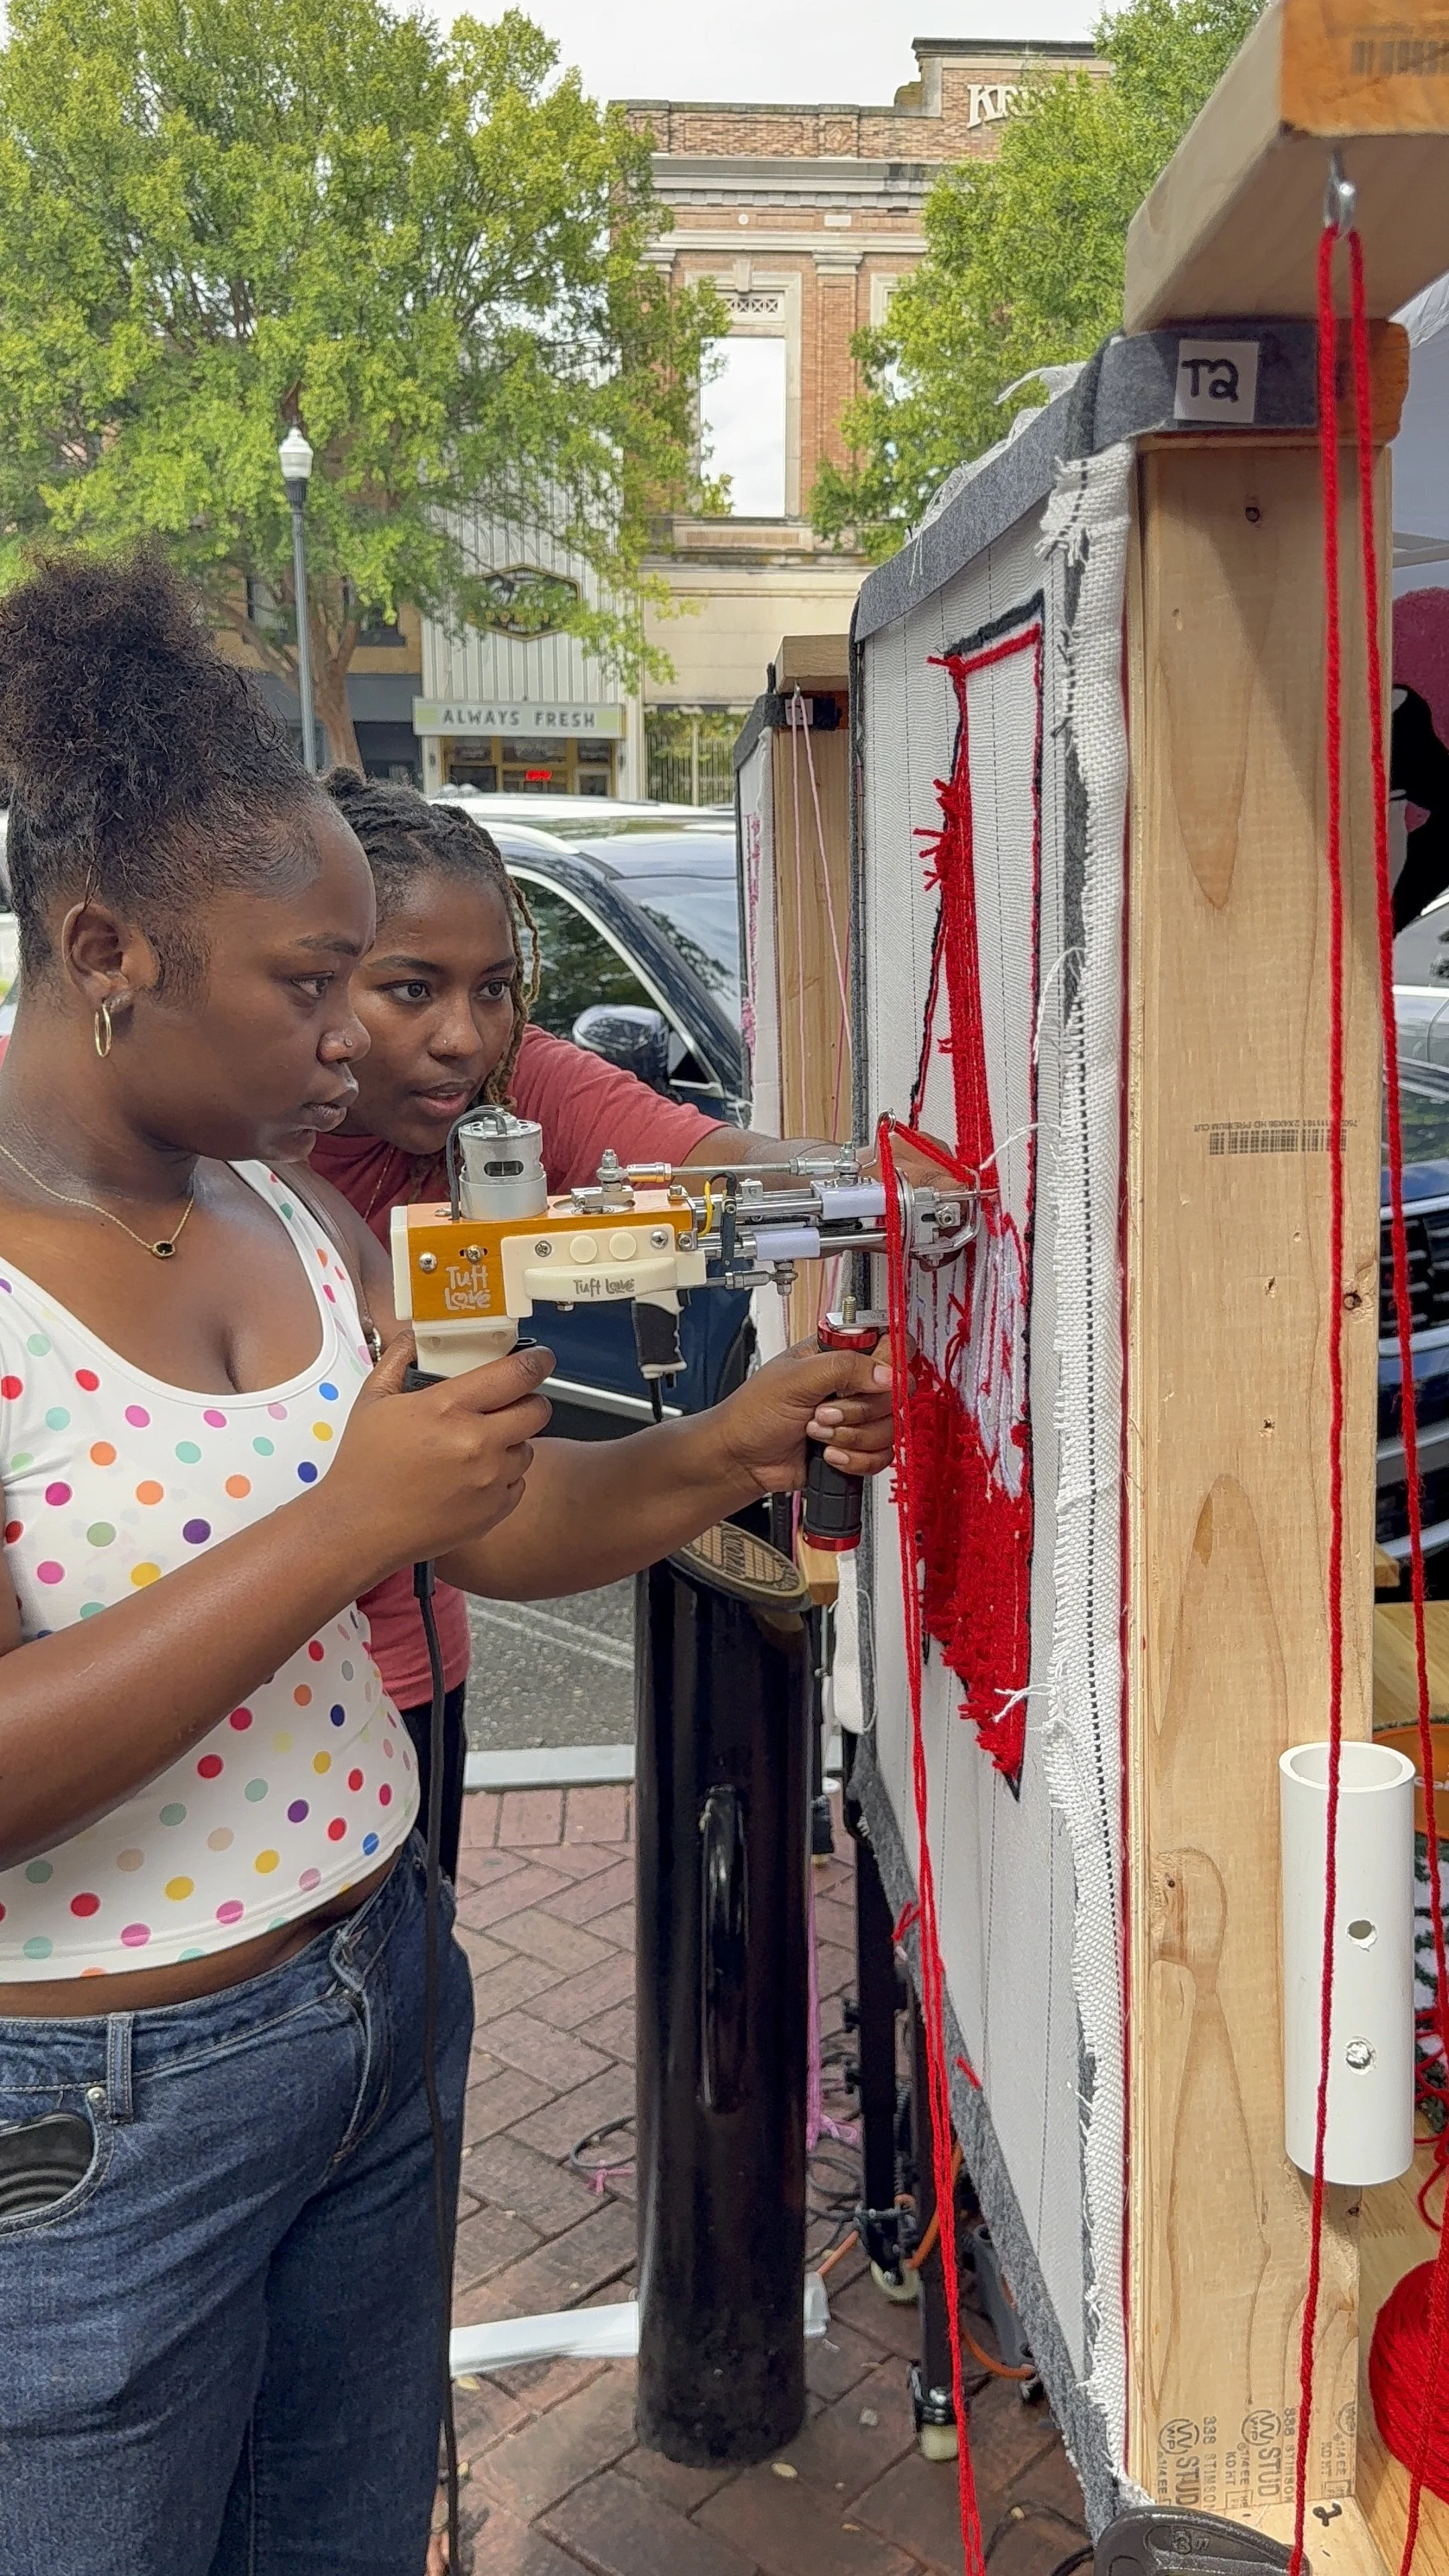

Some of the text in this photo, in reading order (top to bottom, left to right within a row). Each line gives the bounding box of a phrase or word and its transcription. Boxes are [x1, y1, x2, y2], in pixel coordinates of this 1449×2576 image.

[1181, 359, 1239, 403] T2
[443, 708, 596, 728] ALWAYS FRESH
[1193, 1124, 1209, 1132] CUT
[1210, 1122, 1252, 1131] PREMIUM
[1254, 1121, 1267, 1129] HD
[445, 1264, 488, 1291] Tuft
[573, 1277, 601, 1297] Tuft
[1175, 2455, 1200, 2506] STUD
[1258, 2447, 1281, 2497] STUD
